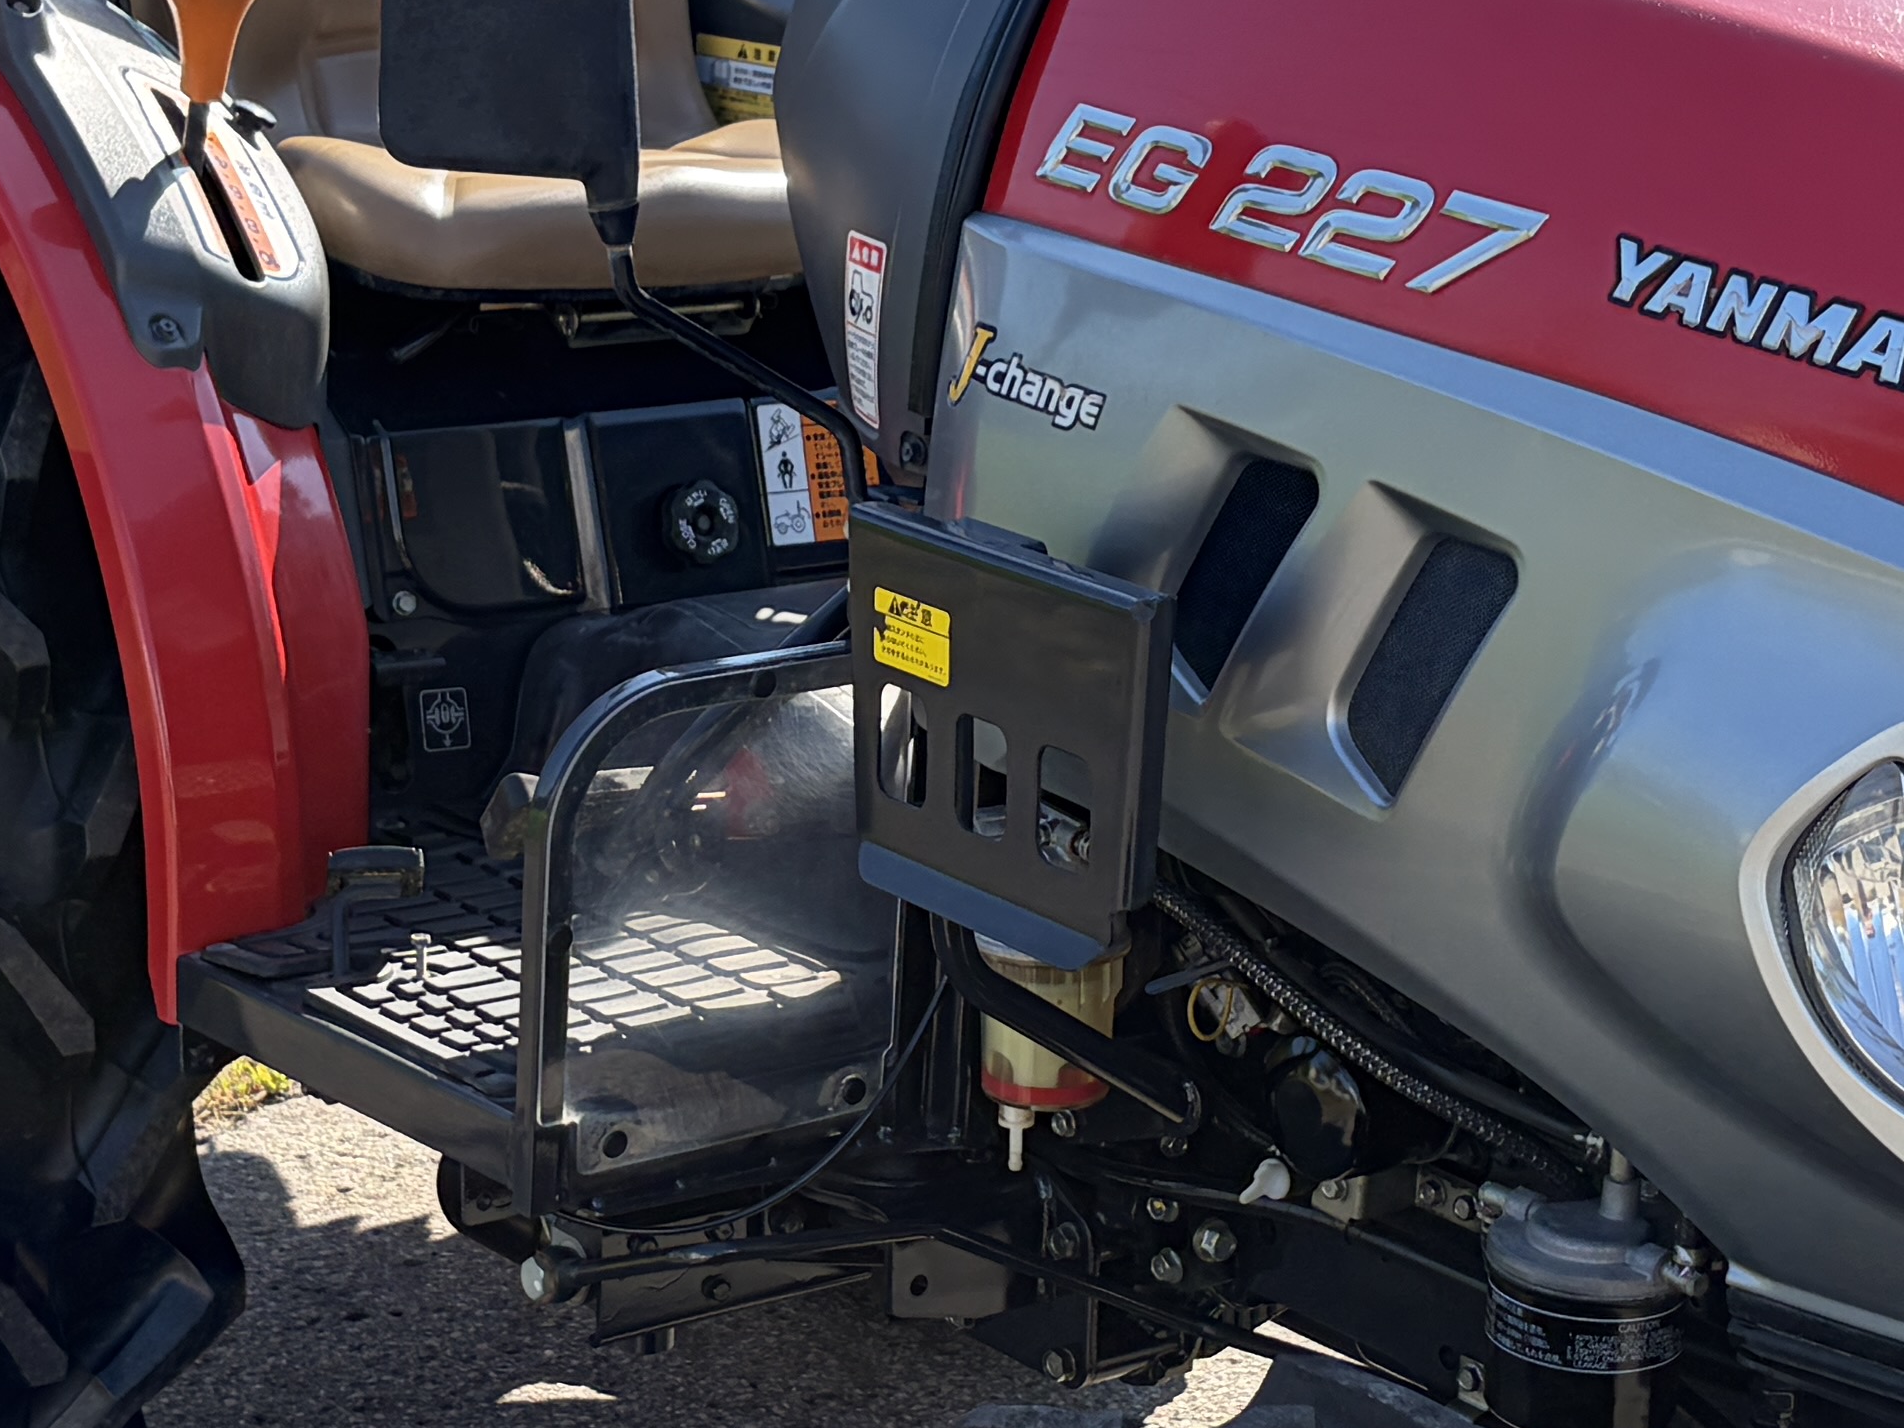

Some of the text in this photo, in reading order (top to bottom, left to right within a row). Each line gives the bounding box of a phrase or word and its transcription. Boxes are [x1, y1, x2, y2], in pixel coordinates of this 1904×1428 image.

[1034, 102, 1551, 295] EG 227
[948, 325, 1105, 429] J-change
